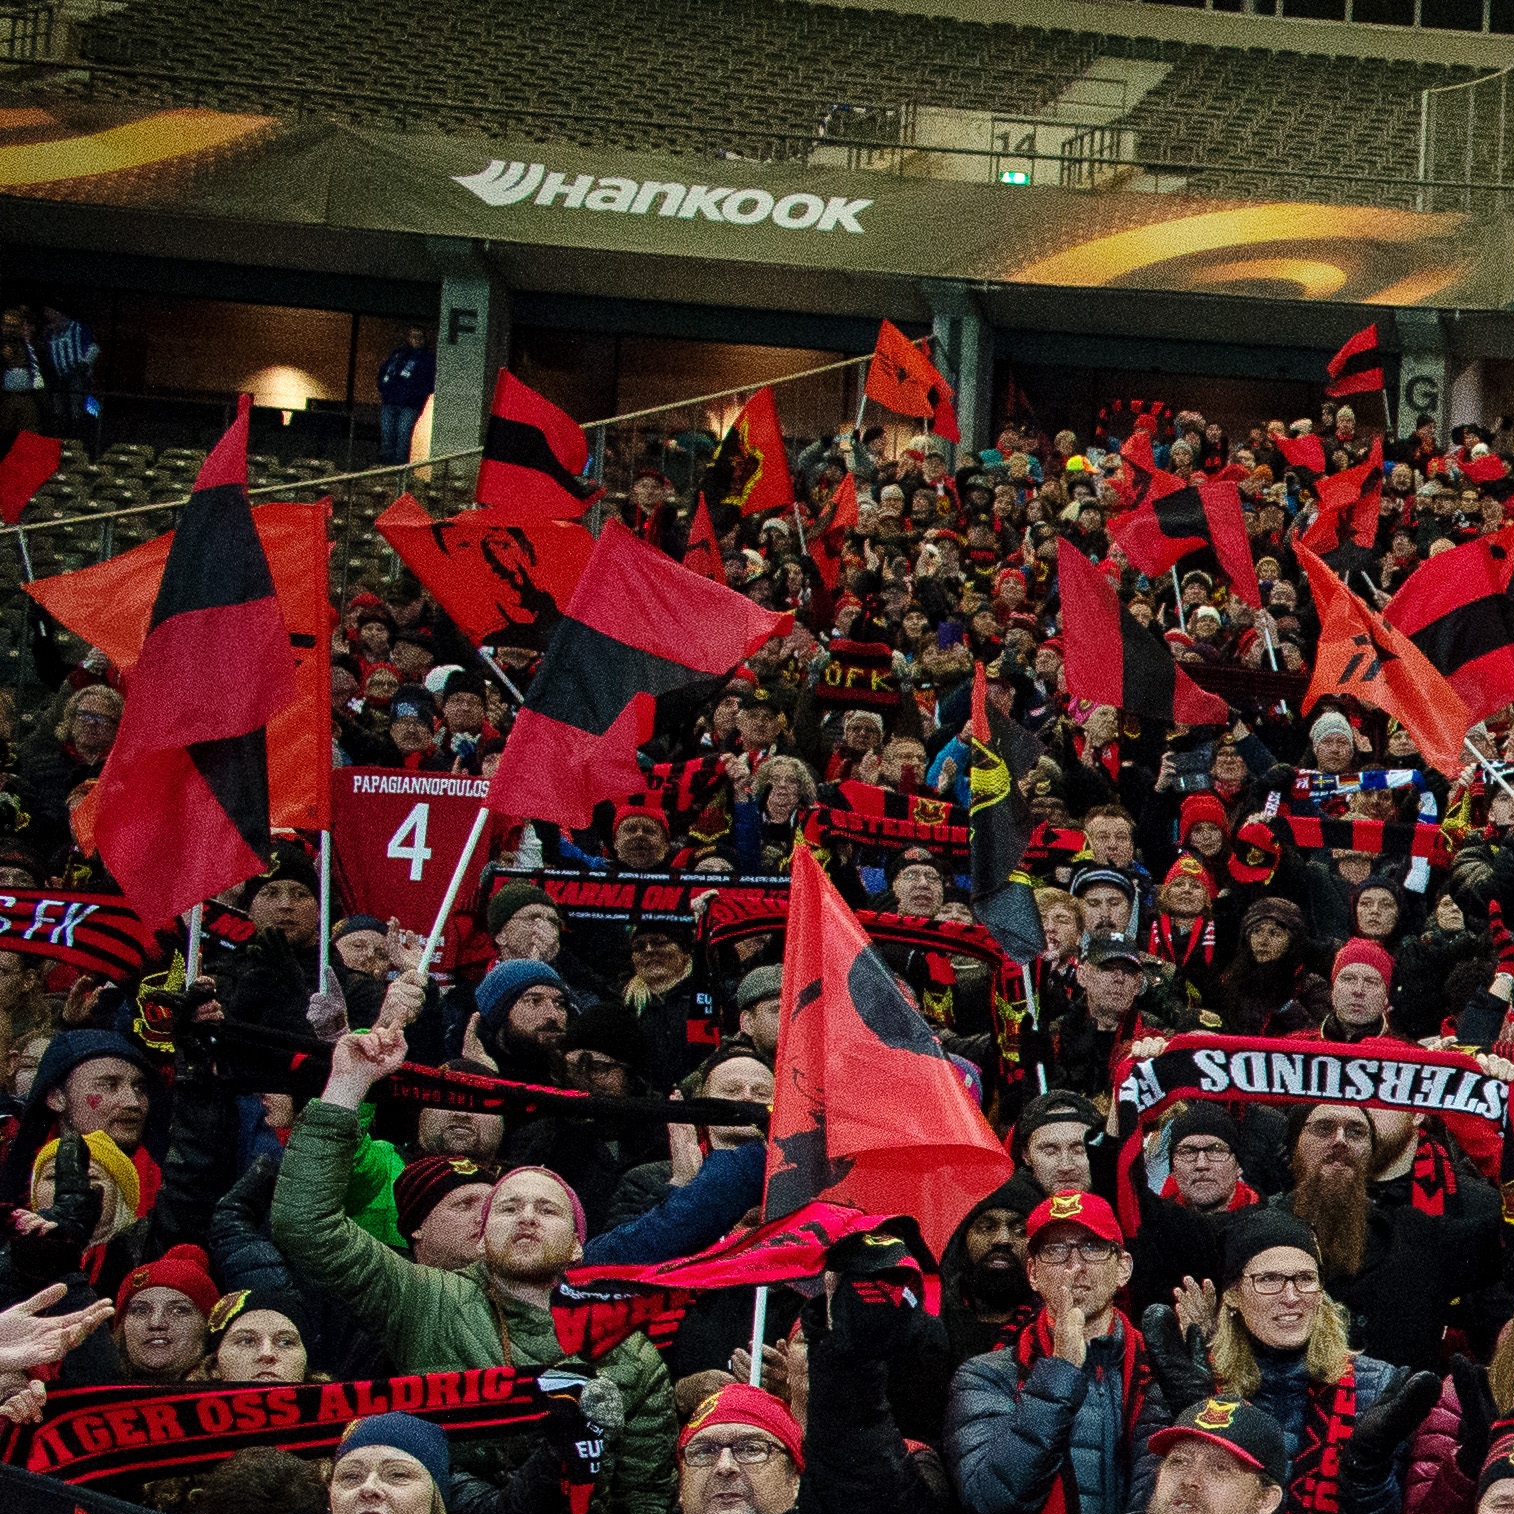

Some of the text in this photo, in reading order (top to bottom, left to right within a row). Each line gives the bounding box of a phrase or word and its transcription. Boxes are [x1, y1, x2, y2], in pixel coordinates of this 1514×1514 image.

[447, 308, 479, 345] F
[1405, 376, 1440, 413] G
[353, 774, 490, 800] PAPAGIANNOPOULOS
[387, 802, 432, 882] 4
[24, 898, 100, 948] FK
[73, 1365, 517, 1455] GER OSS ALDRIG
